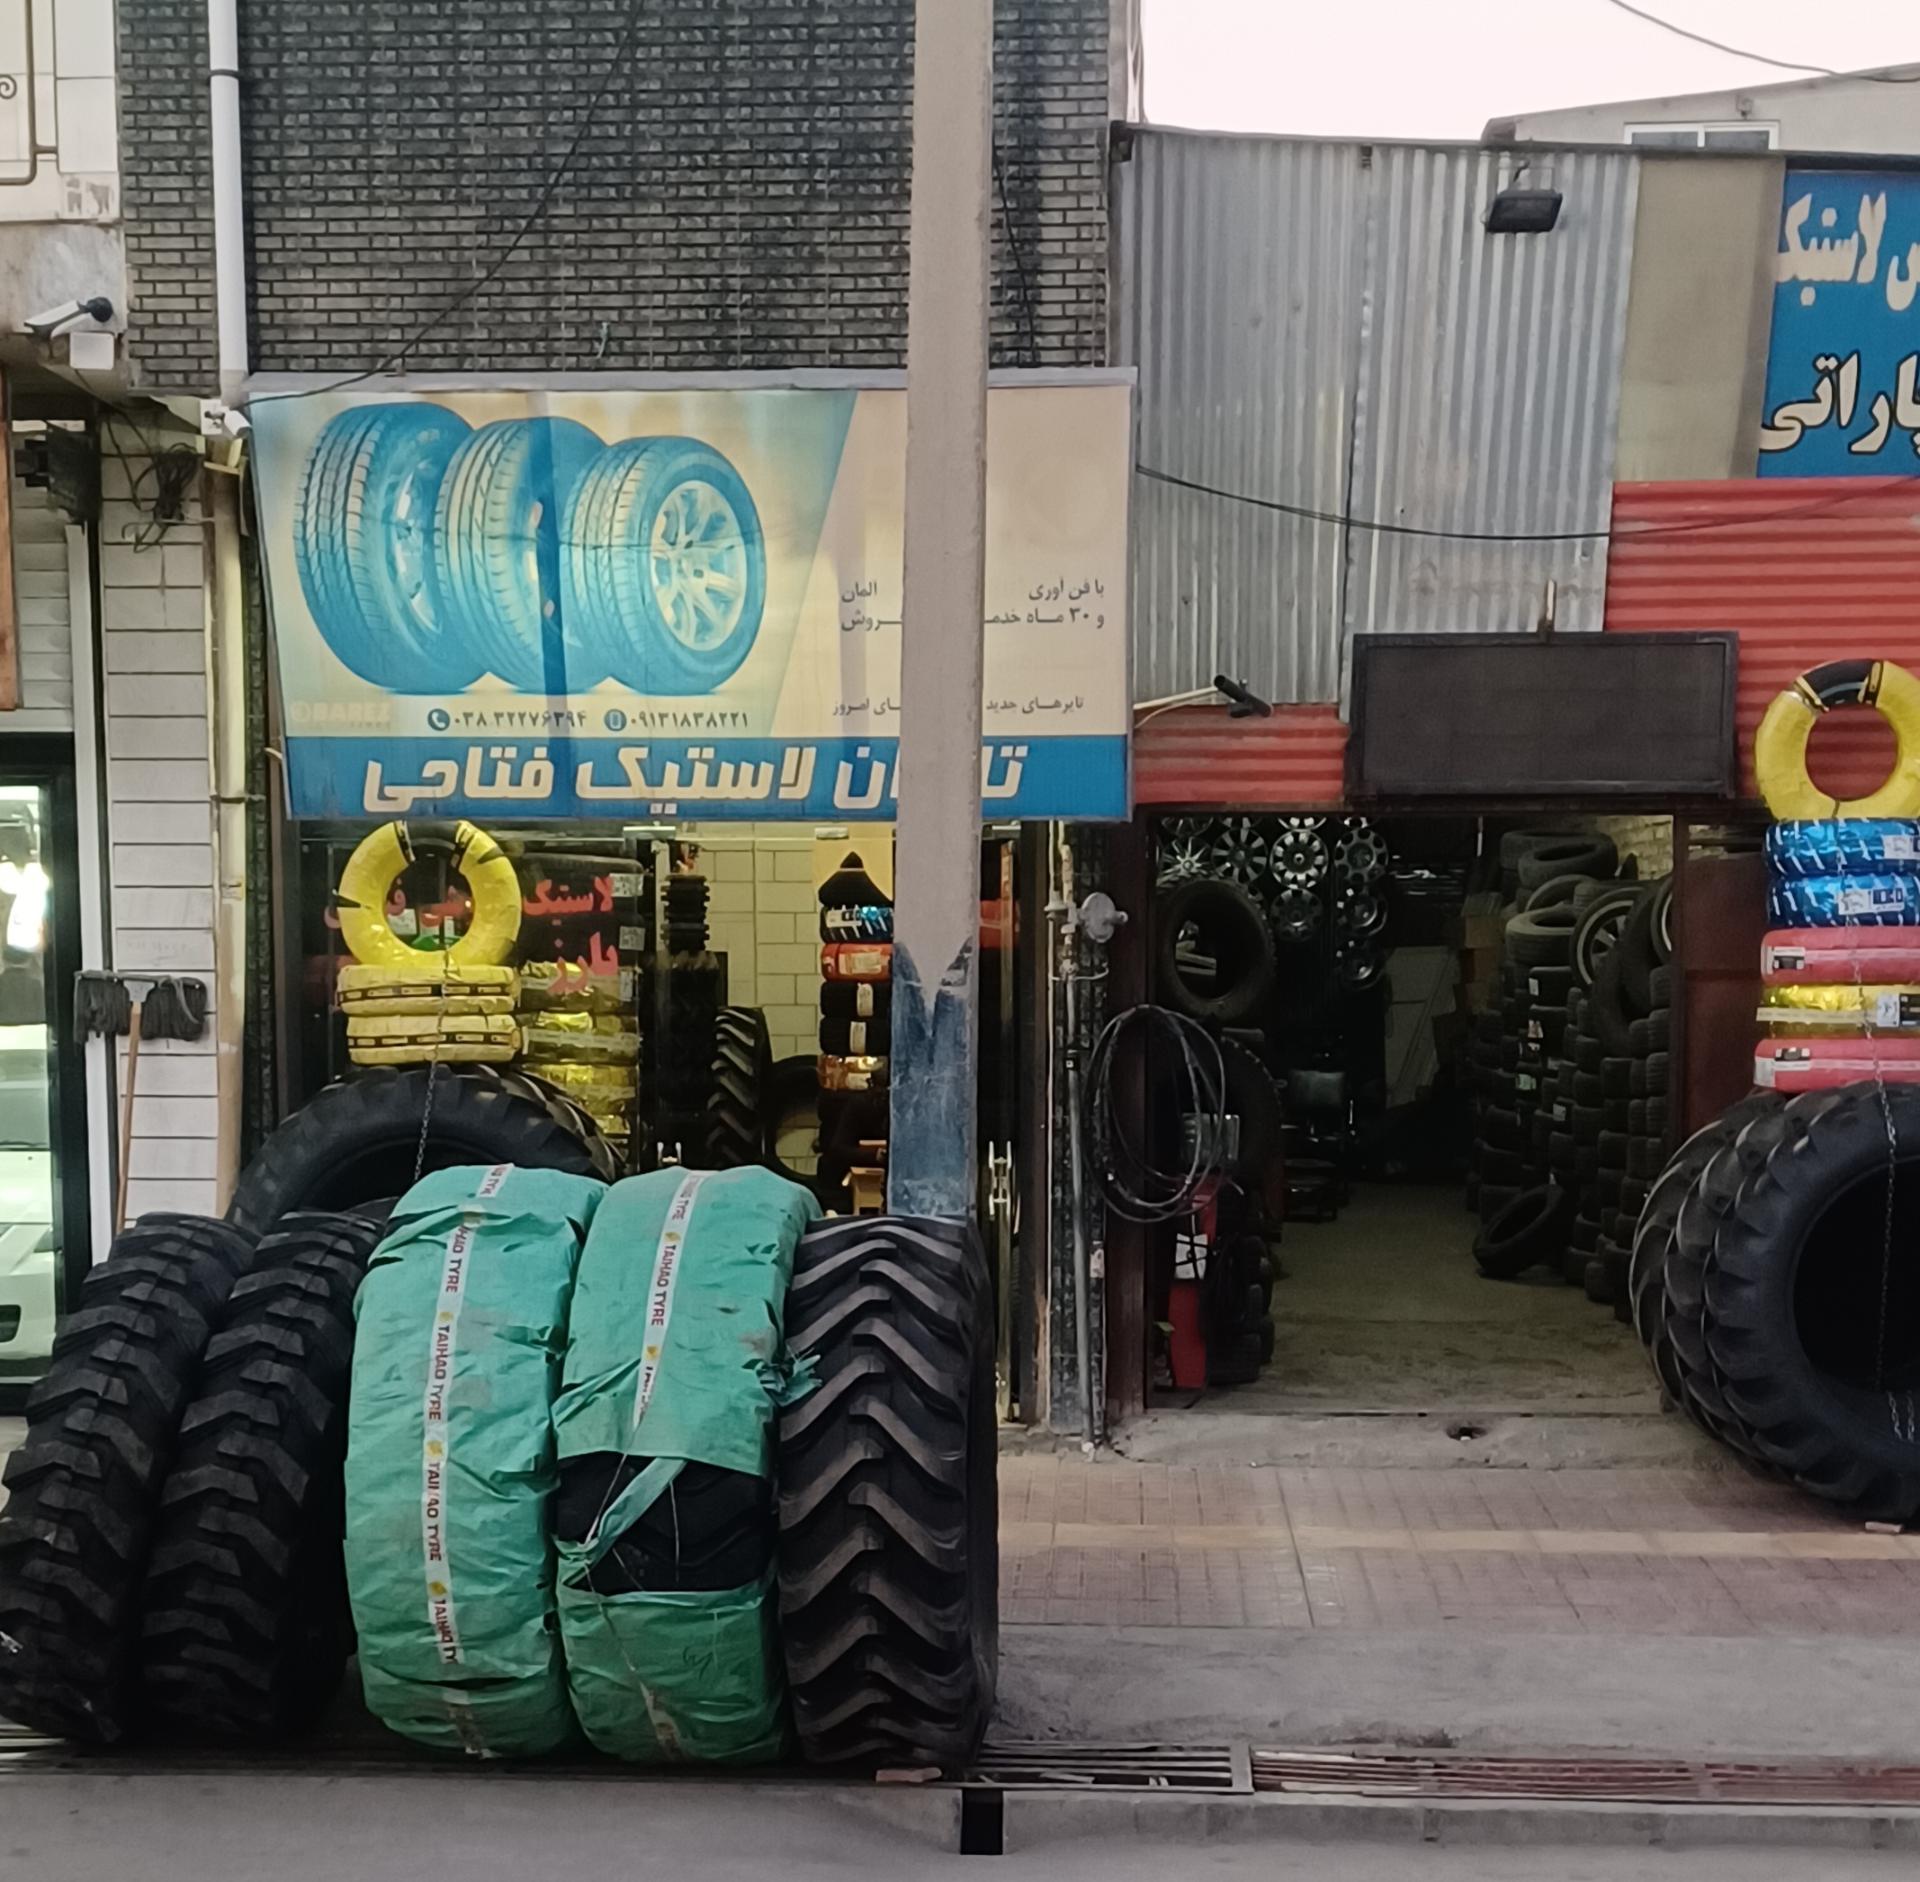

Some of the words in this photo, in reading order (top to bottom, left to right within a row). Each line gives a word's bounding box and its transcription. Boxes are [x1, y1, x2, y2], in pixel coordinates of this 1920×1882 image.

[841, 608, 903, 631] روش
[1026, 607, 1064, 623] ماه
[363, 746, 555, 812] فتاحی
[575, 745, 817, 815] لاستیک
[445, 1258, 463, 1294] TYRE
[656, 1243, 678, 1288] TAIHAO
[650, 1290, 668, 1327] TYRE
[433, 1324, 451, 1381] TAIHAO
[428, 1384, 445, 1421] TYRE
[426, 1524, 442, 1562] TYRE
